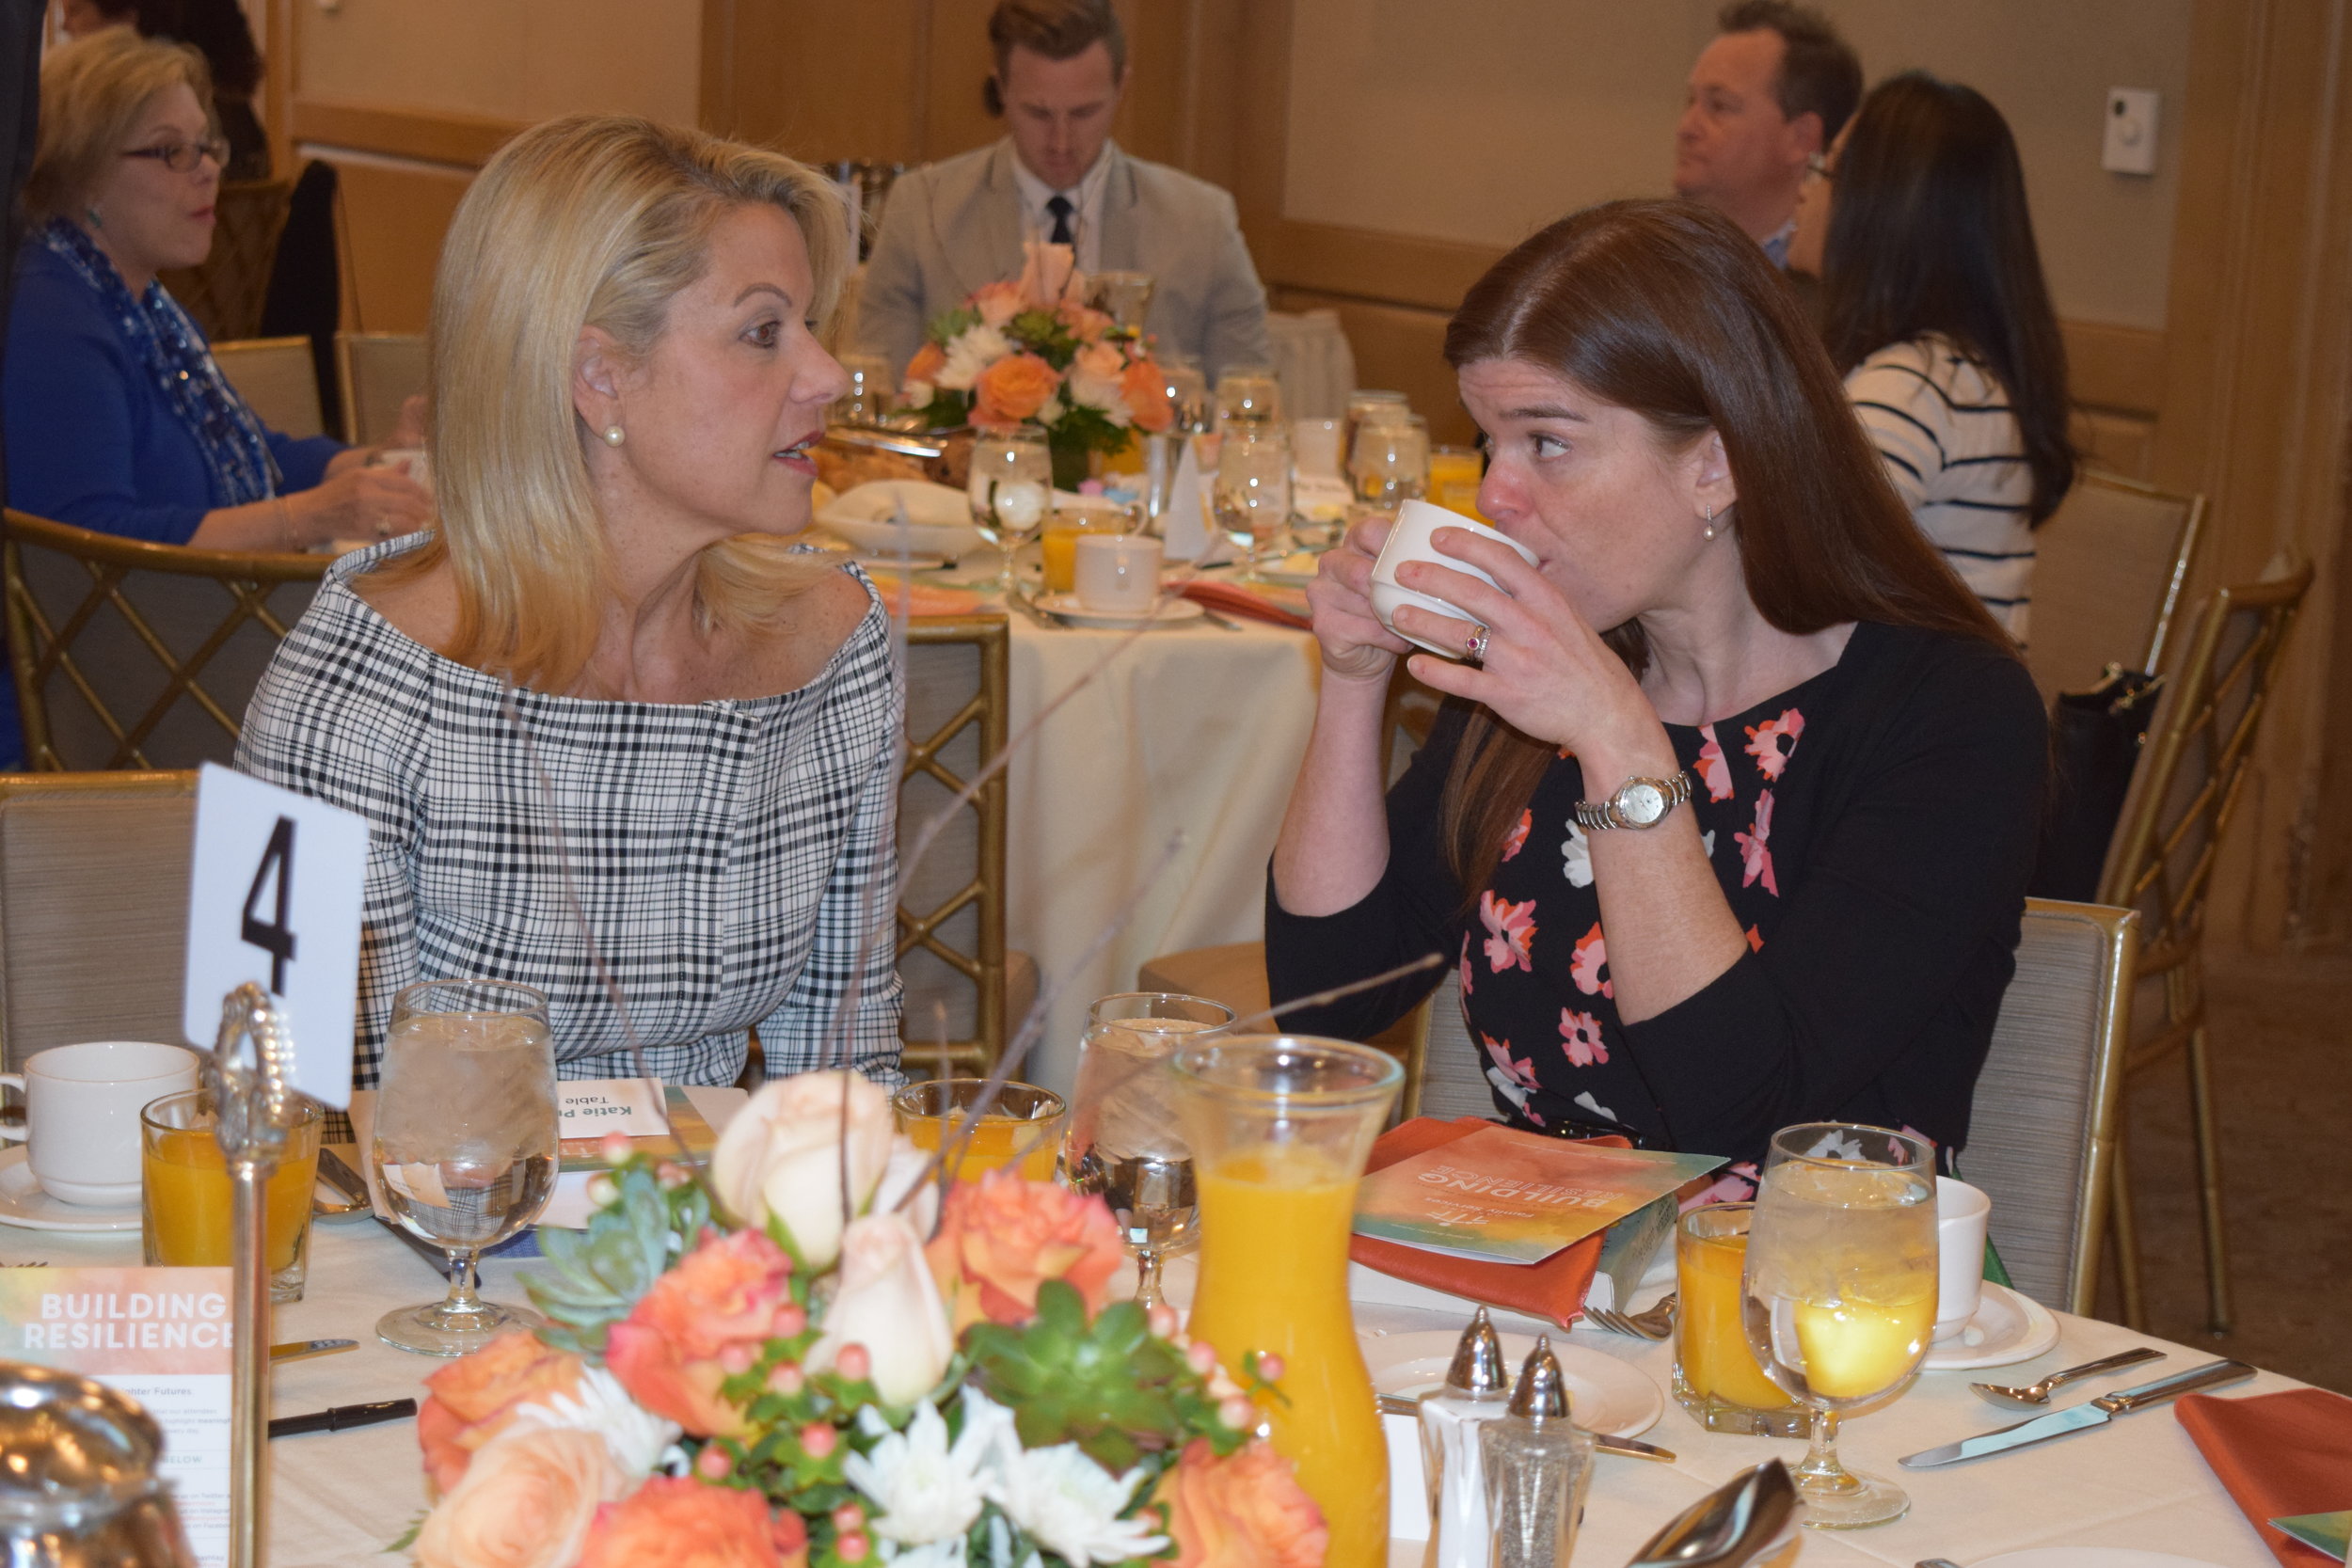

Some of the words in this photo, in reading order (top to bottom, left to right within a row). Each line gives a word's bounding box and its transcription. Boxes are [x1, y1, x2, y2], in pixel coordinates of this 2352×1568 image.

[241, 813, 297, 998] 4
[565, 1097, 609, 1105] Table
[583, 1106, 631, 1117] Katie
[1417, 1172, 1612, 1208] BUILDING
[1429, 1164, 1624, 1200] RESILIENCE
[1422, 1195, 1484, 1212] Services
[1486, 1208, 1535, 1219] Family
[42, 1293, 226, 1319] BUILDING
[24, 1322, 233, 1349] RESILIENCE
